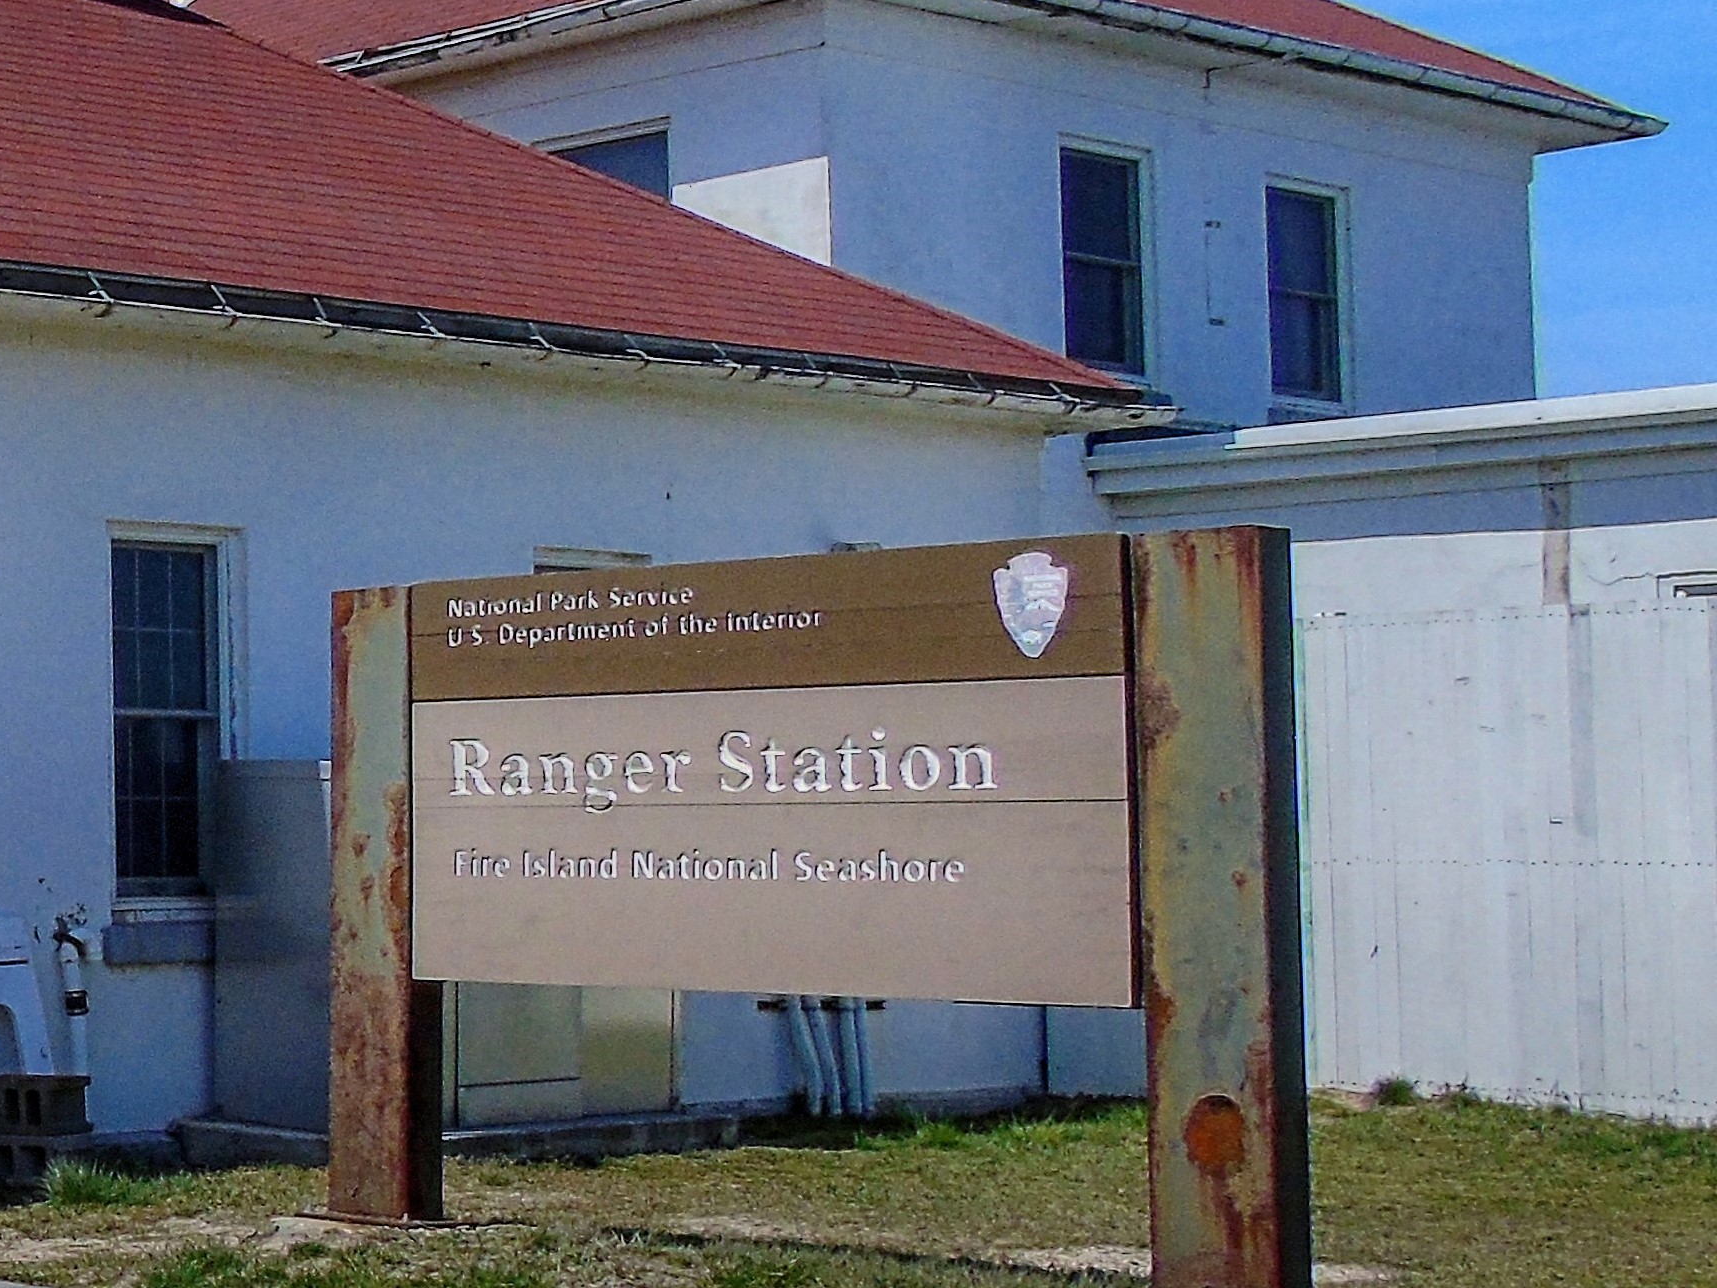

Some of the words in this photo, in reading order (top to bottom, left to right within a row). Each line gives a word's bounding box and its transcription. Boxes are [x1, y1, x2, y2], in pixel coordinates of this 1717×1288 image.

[446, 591, 542, 619] National
[550, 588, 599, 611] Park
[609, 586, 694, 609] Service
[498, 618, 636, 649] Department
[643, 616, 669, 637] of
[678, 612, 716, 636] the
[449, 738, 692, 813] Ranger
[718, 726, 998, 794] Station
[454, 848, 511, 879] Fire
[522, 848, 618, 880] Island
[631, 848, 778, 881] National
[793, 848, 965, 883] Seashore
